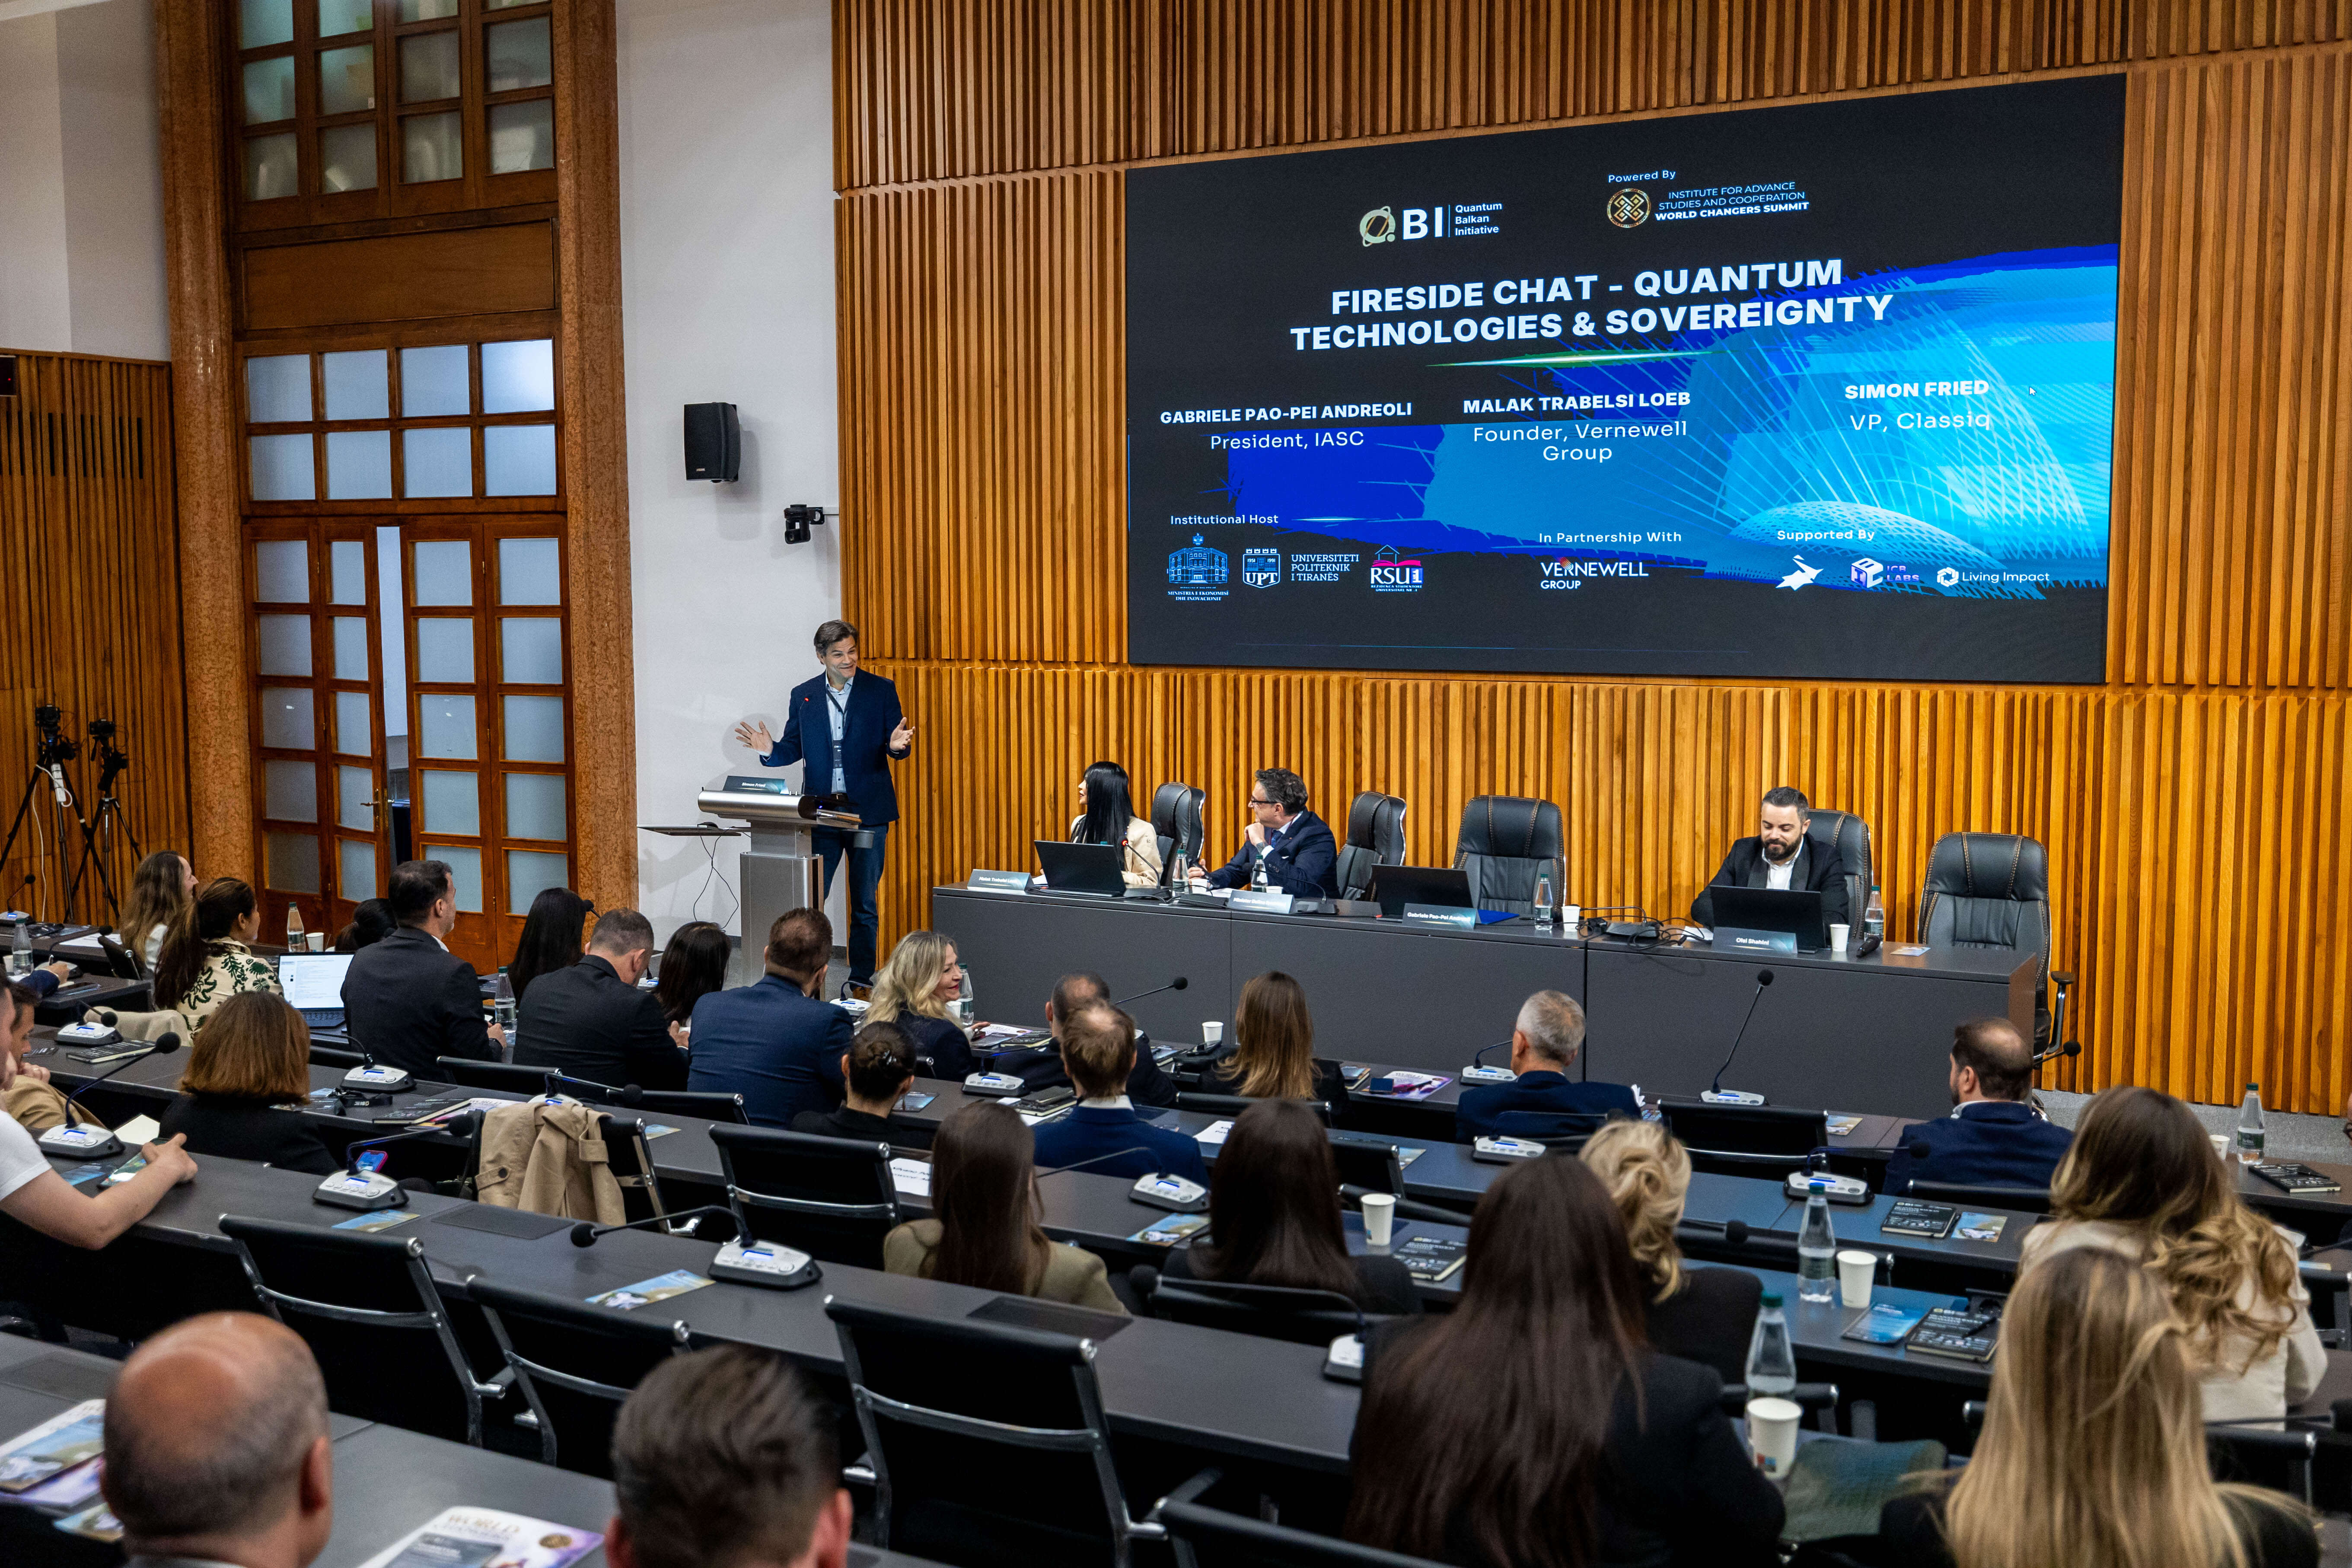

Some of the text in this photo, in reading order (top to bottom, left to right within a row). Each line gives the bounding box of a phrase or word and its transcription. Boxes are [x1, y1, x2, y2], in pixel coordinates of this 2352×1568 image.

[1609, 170, 1676, 183] Powered By
[1669, 182, 1795, 199] INSTITUTE FOR ADVANCE
[1455, 204, 1502, 213] Quantum
[1659, 192, 1804, 210] STUDIES AND COOPERATION
[1455, 215, 1489, 224] Balkan
[1655, 202, 1809, 220] WORLD CHANGERS SUMMIT
[1455, 225, 1499, 236] Initiative
[1332, 282, 1483, 314] FIRESIDE
[1494, 275, 1598, 304] CHAT
[1635, 259, 1841, 297] QUANTUM
[1291, 294, 1893, 350] TECHNOLOGIES & SOVEREIGNTY
[1845, 380, 1989, 399] SIMON FRIED
[1464, 392, 1690, 413] MALAK TRABELSI LOEB
[1160, 403, 1411, 424] GABRIELE PAO-PEI ANDREOLI
[1850, 411, 1990, 433] VP, Classiq
[1211, 431, 1364, 449] President, IASC
[1474, 421, 1686, 442] Founder, Vernewell
[1543, 446, 1612, 463] Group
[1171, 514, 1278, 524] Institutional Host
[1539, 532, 1681, 544] In Partnership With
[1777, 529, 1875, 542] Supported By
[1540, 562, 1649, 577] VERNEWELL
[1962, 572, 2049, 583] Living Impact
[1245, 572, 1278, 585] UPT
[1540, 580, 1581, 589] GROUP
